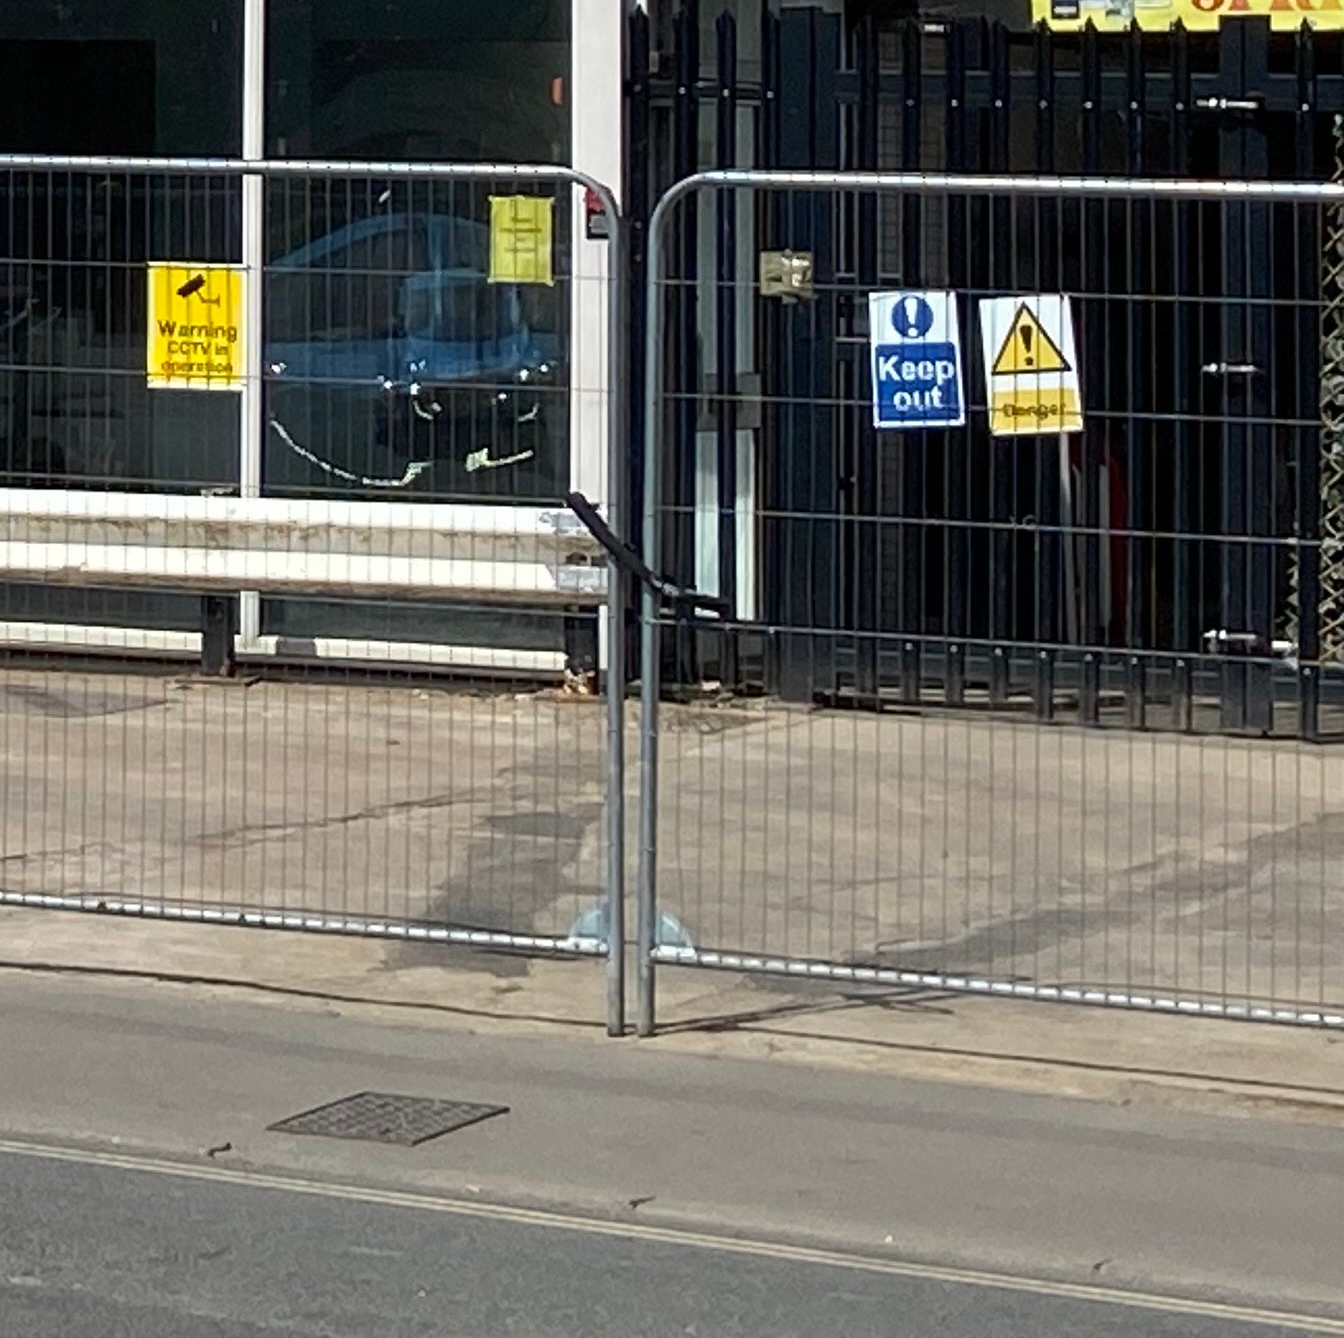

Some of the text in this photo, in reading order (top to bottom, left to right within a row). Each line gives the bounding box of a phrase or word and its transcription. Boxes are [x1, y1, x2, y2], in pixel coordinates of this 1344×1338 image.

[157, 319, 238, 343] Warning
[878, 355, 955, 386] Keep
[893, 386, 942, 412] out
